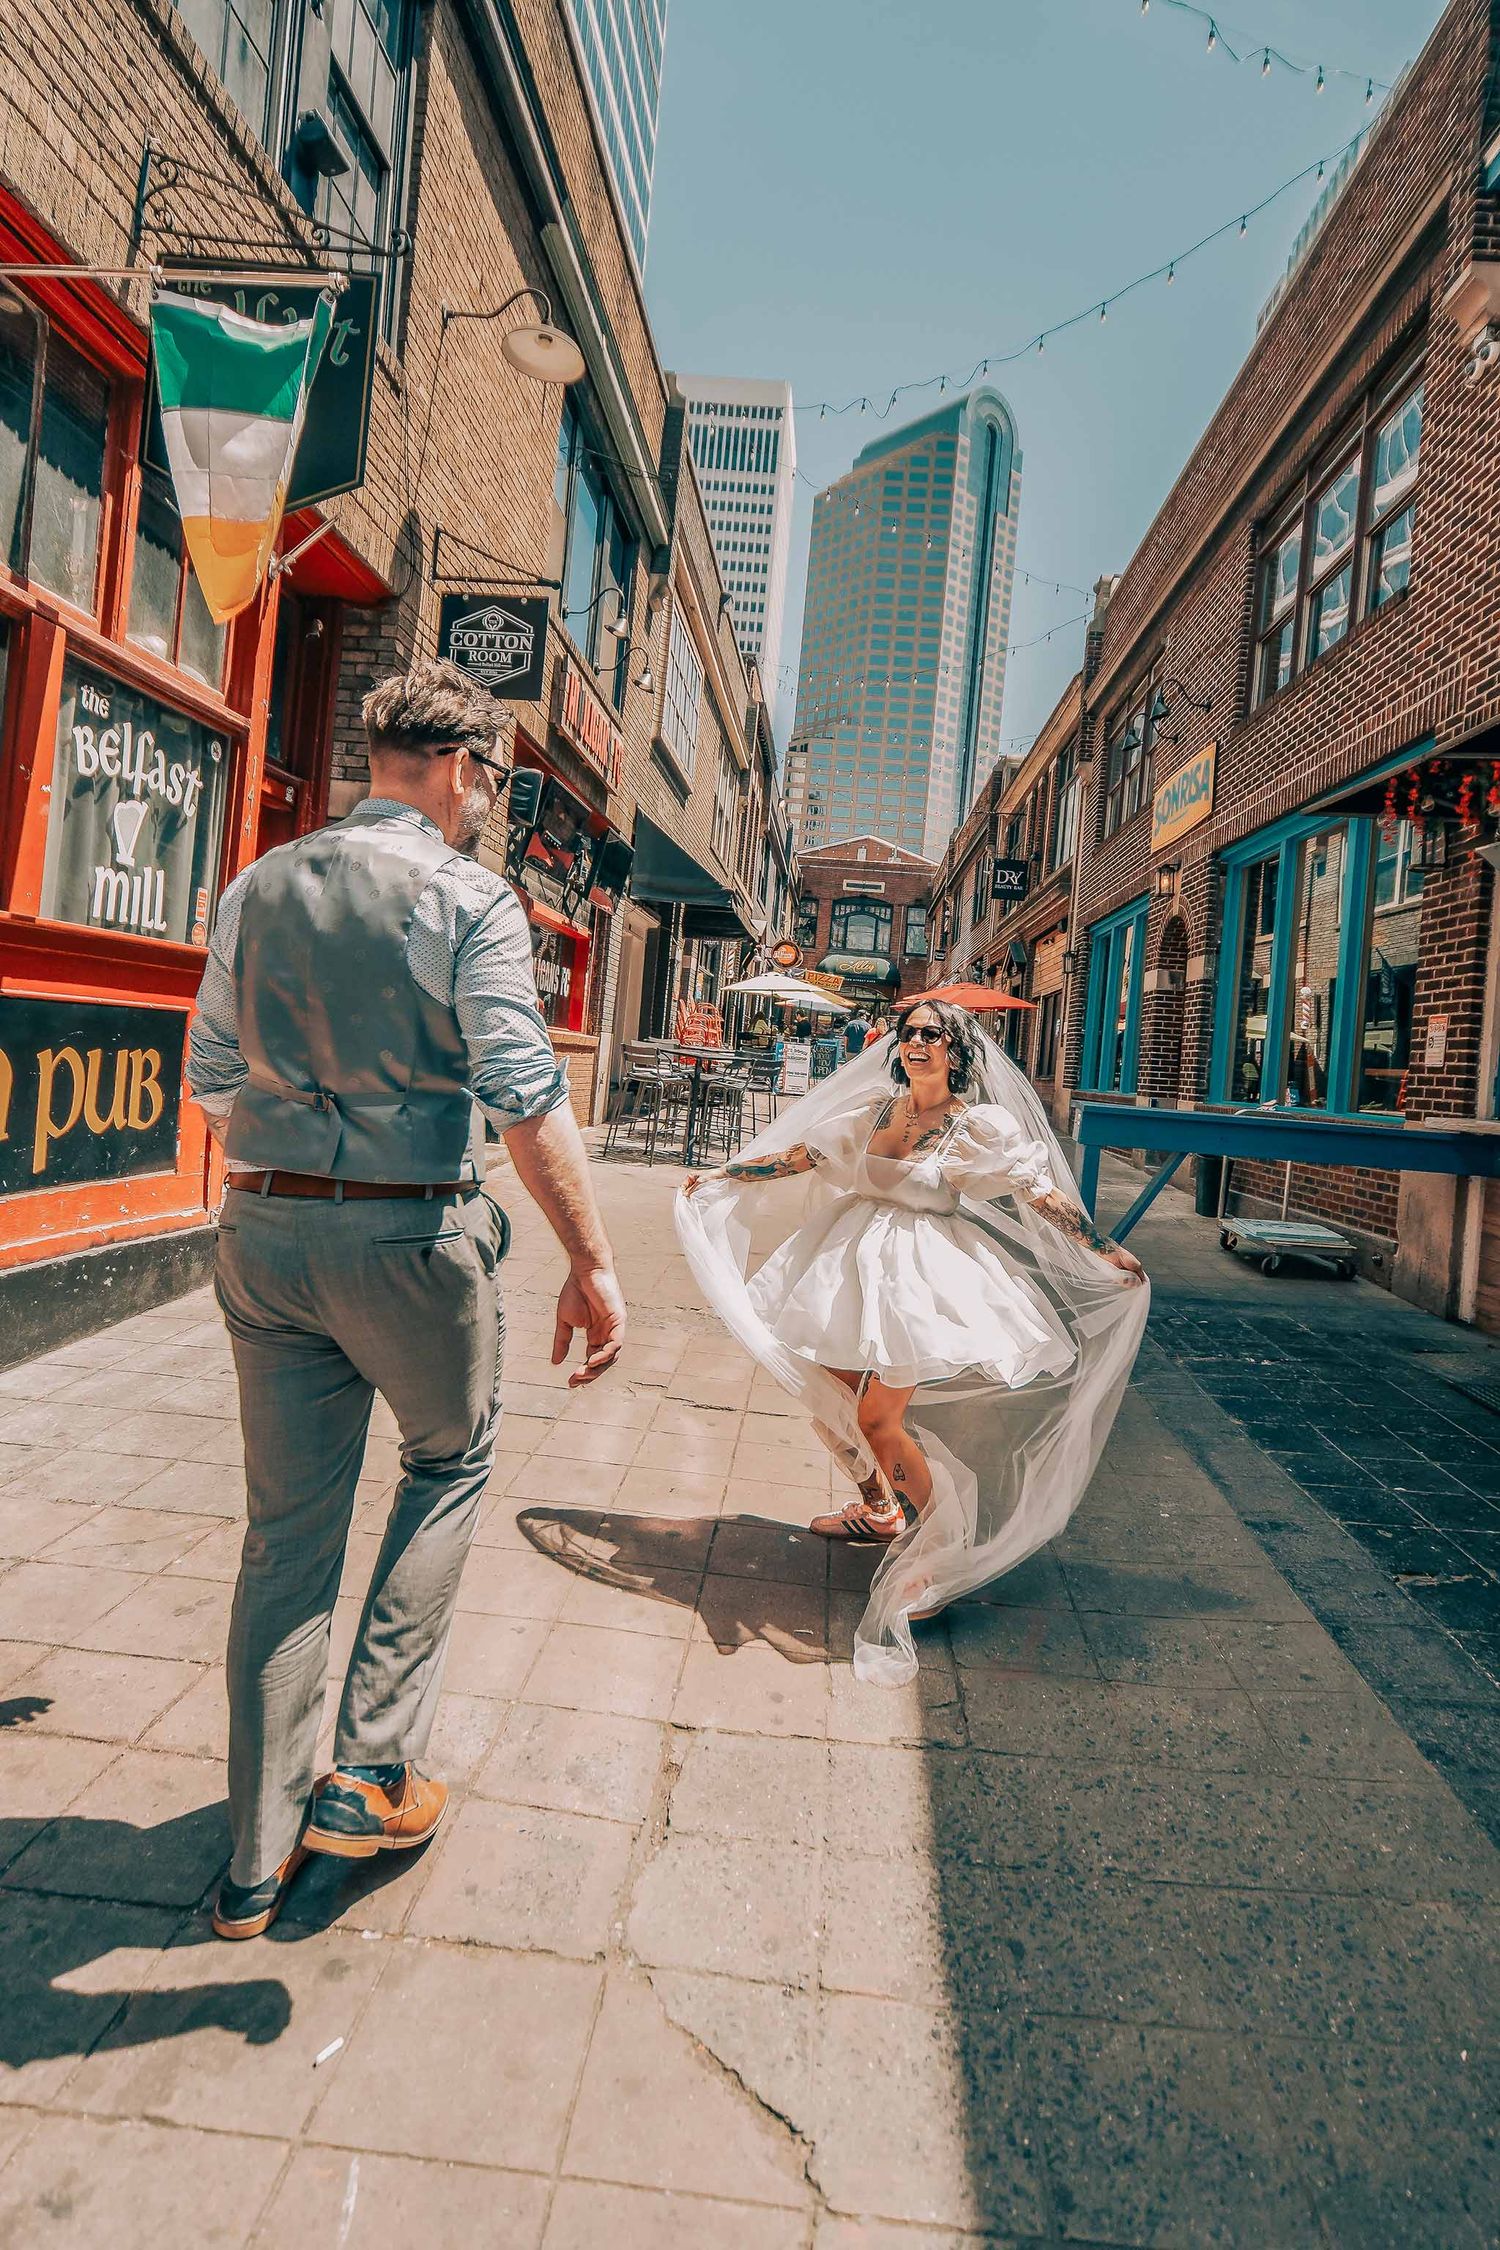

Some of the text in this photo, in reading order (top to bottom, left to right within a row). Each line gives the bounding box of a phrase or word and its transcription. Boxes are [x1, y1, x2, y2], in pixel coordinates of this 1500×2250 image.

[449, 632, 533, 651] COTTON
[468, 650, 513, 663] ROOM
[81, 684, 111, 719] the
[995, 869, 1025, 885] DRY
[807, 971, 840, 986] PIZZA
